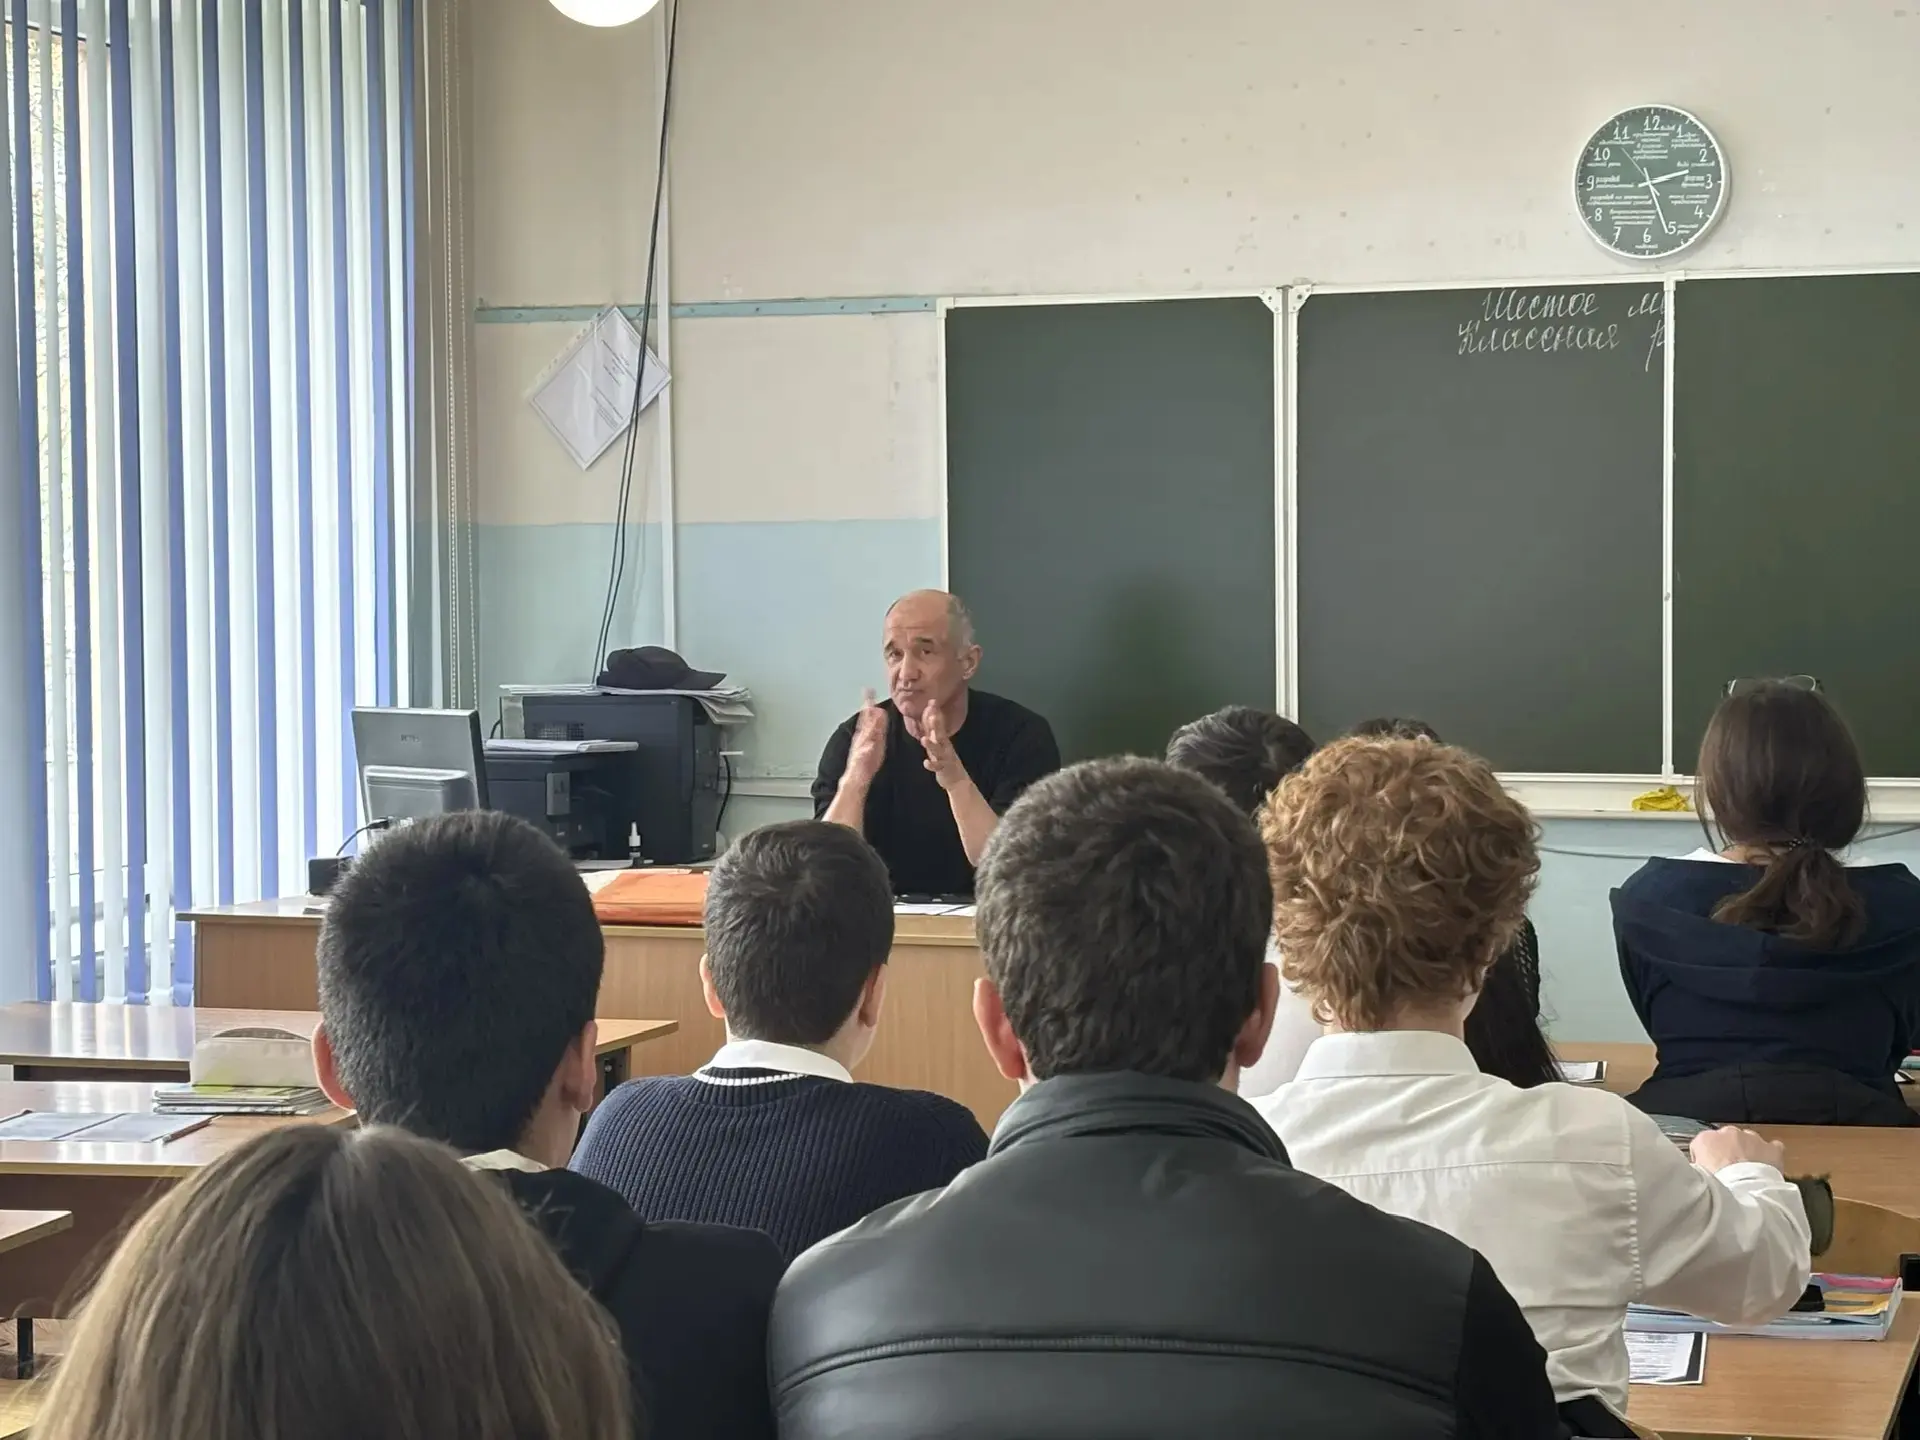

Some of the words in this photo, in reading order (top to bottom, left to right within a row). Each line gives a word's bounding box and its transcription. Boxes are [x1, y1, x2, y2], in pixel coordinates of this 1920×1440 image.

[1643, 115, 1660, 131] 12
[1613, 125, 1630, 140] 11
[1676, 124, 1684, 138] 1
[1593, 147, 1611, 161] 10
[1698, 148, 1708, 162] 2
[1586, 175, 1595, 191] 9
[1705, 173, 1713, 189] 3
[1594, 207, 1603, 222] 8
[1694, 204, 1704, 219] 4
[1613, 226, 1622, 241] 7
[1643, 227, 1652, 243] 6
[1667, 220, 1677, 235] 5
[1482, 288, 1599, 322] Шестое
[1458, 319, 1621, 355] Классная
